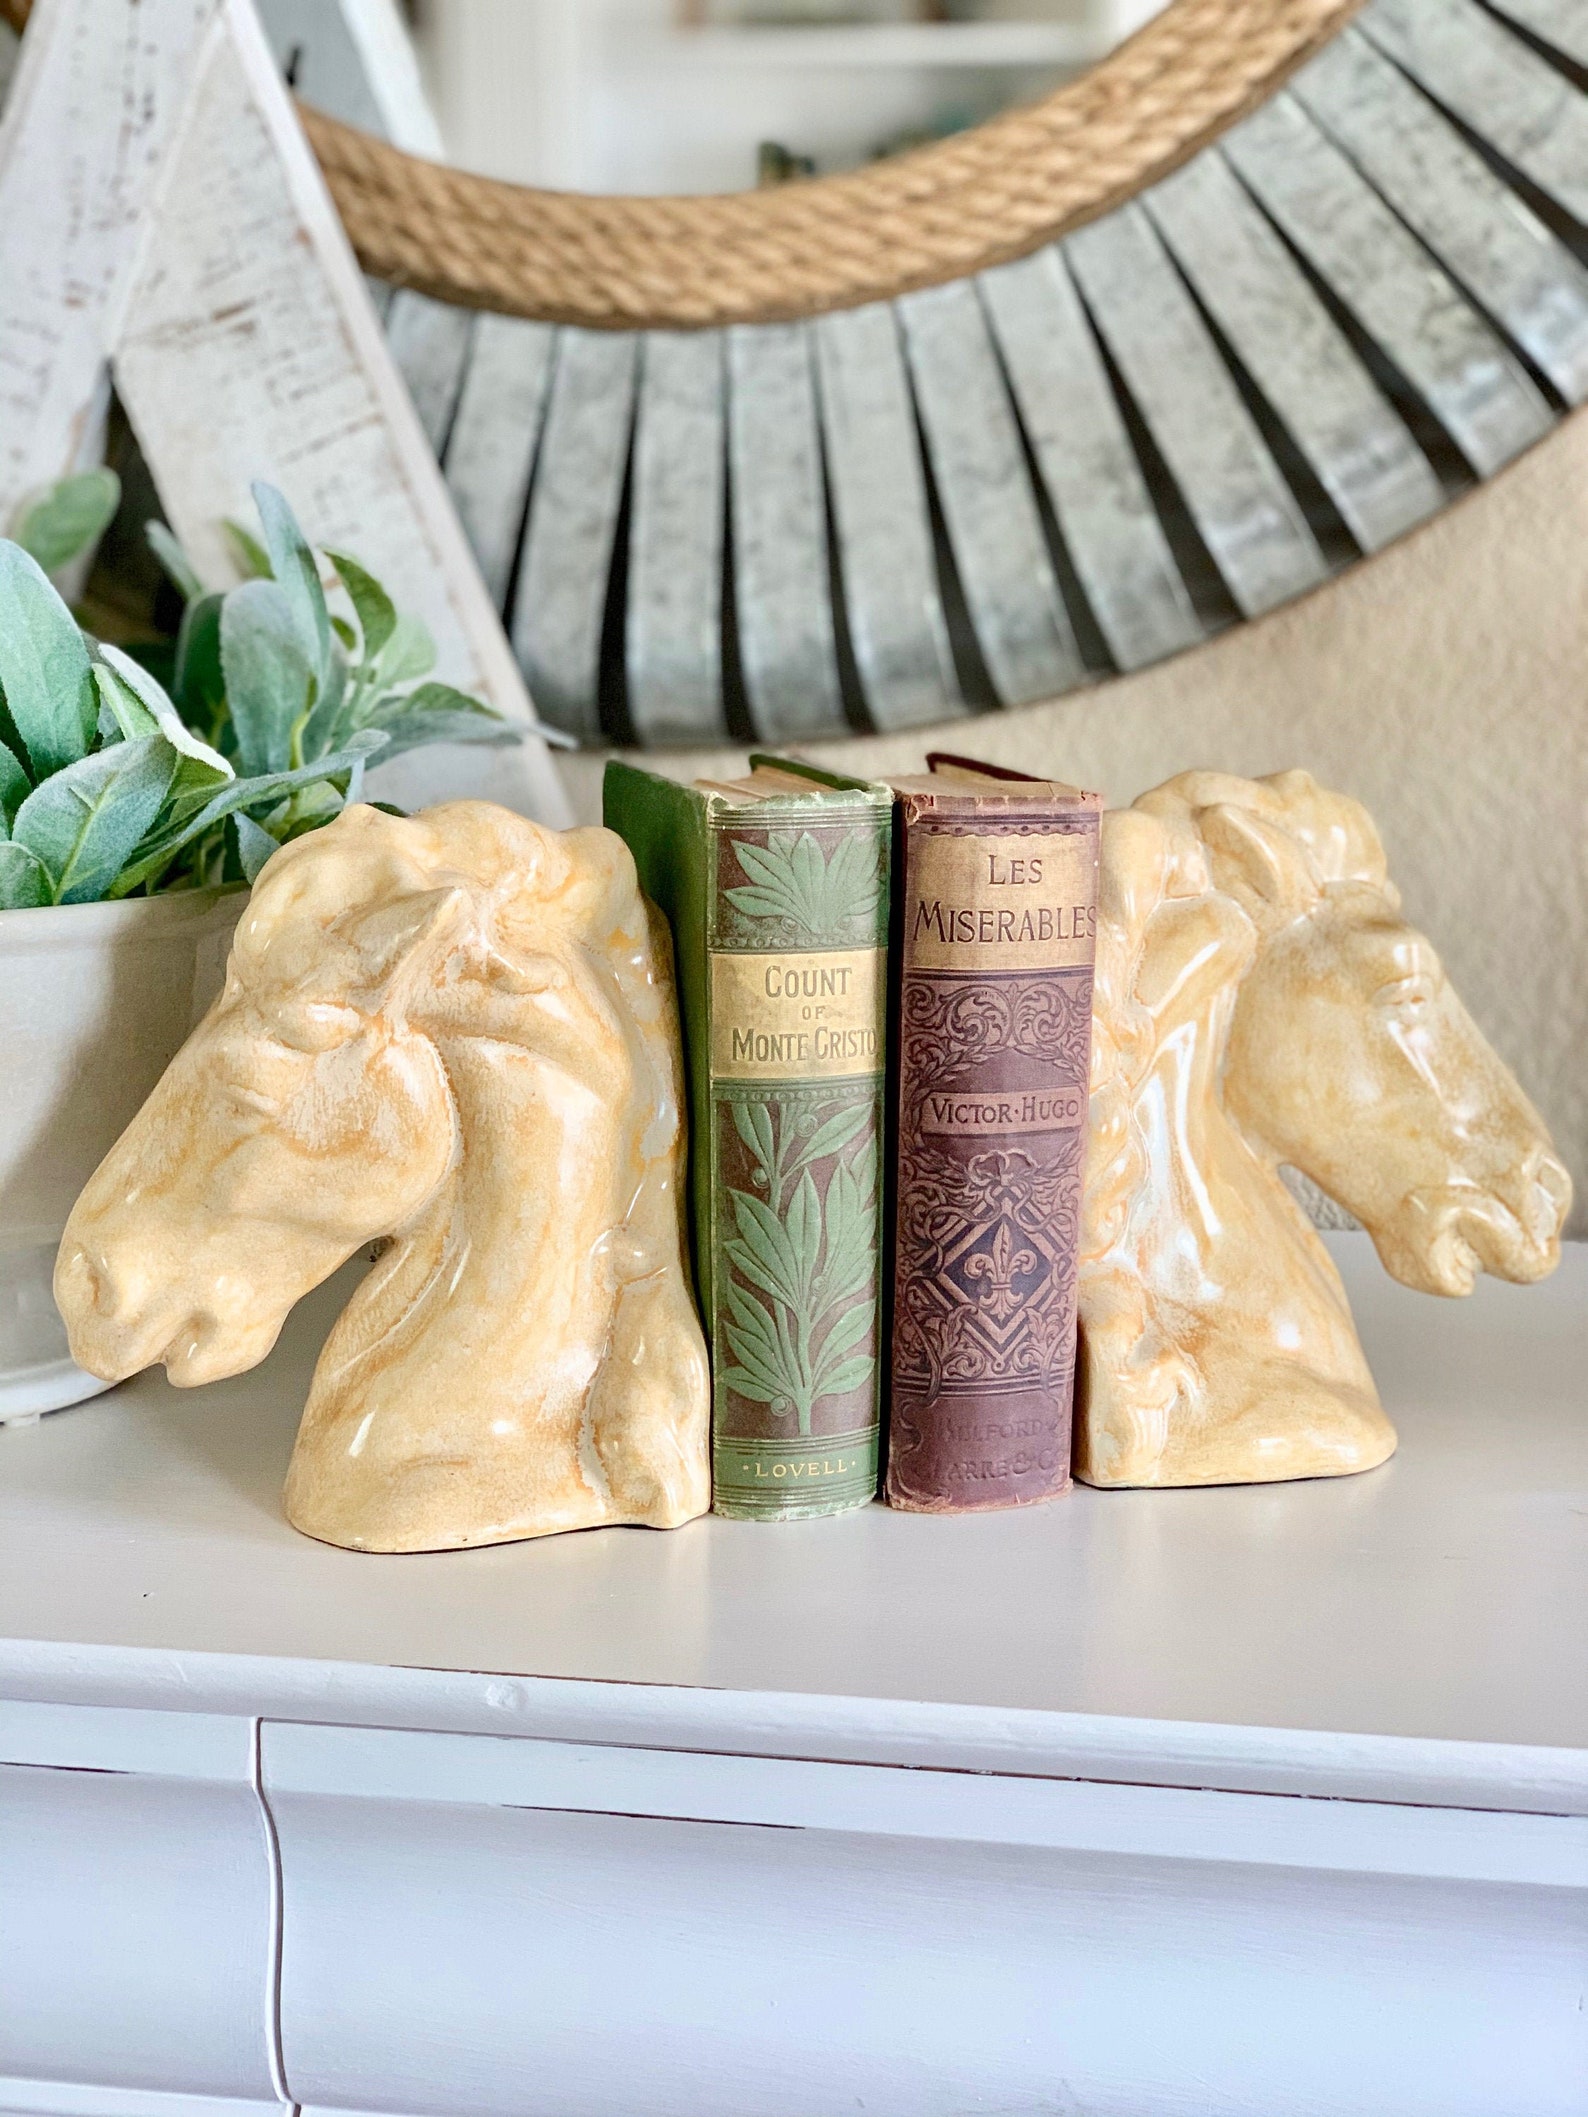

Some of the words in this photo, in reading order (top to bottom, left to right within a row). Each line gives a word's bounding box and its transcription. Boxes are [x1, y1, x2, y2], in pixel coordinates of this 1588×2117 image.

[988, 854, 1043, 885] LES
[913, 900, 1097, 943] MISERABLES
[765, 965, 853, 998] COUNT
[802, 1005, 826, 1020] OF
[731, 1027, 809, 1062] MONTE
[814, 1026, 878, 1060] CRISTO
[754, 1459, 848, 1479] LOVELL
